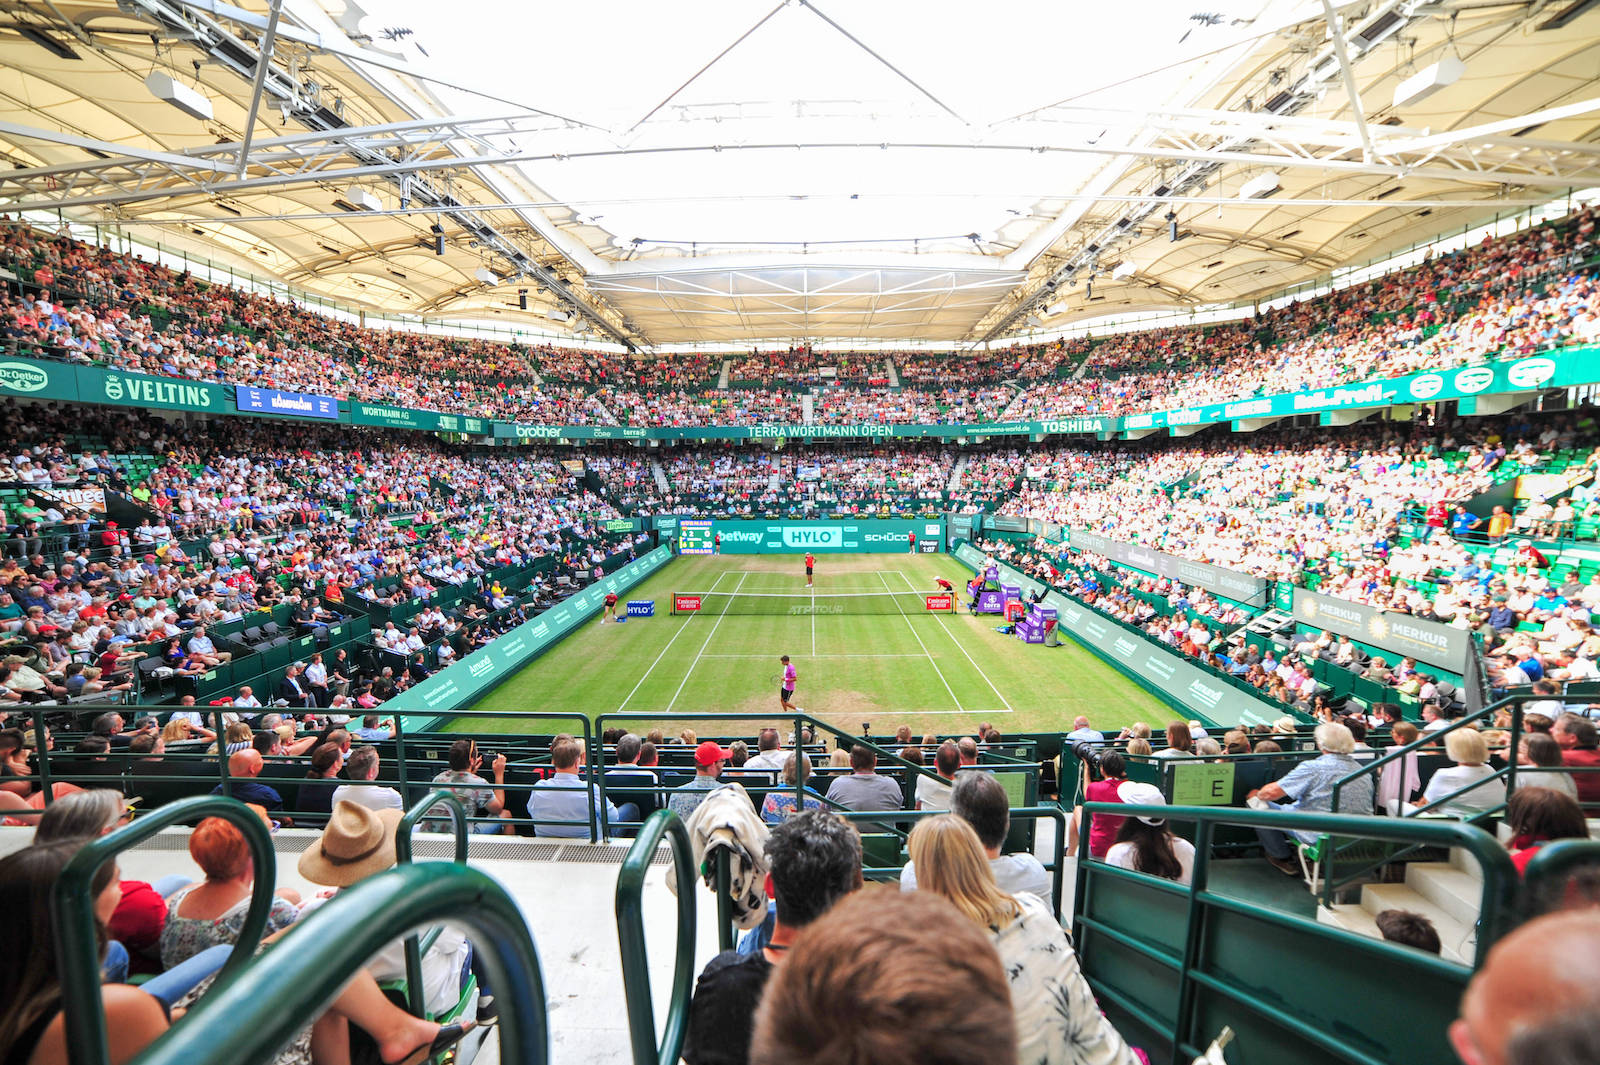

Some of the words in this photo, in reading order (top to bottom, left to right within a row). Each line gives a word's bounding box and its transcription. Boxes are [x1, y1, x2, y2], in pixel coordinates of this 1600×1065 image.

[125, 378, 210, 407] VELTINS
[362, 406, 400, 418] WORTMANN
[400, 411, 409, 420] AG
[516, 425, 561, 437] brother
[748, 427, 787, 437] TERRA
[789, 426, 858, 437] WORTMANN
[862, 424, 893, 436] OPEN
[1041, 420, 1102, 432] TOSHIBA
[717, 530, 763, 544] betway
[792, 531, 831, 543] HYLO
[627, 606, 649, 614] HYLO
[815, 604, 844, 614] TOUR
[1320, 602, 1362, 623] MERKUR
[1392, 622, 1448, 648] MERKUR
[469, 655, 492, 674] Amundi
[1189, 679, 1224, 702] Amundi
[1212, 780, 1224, 797] E
